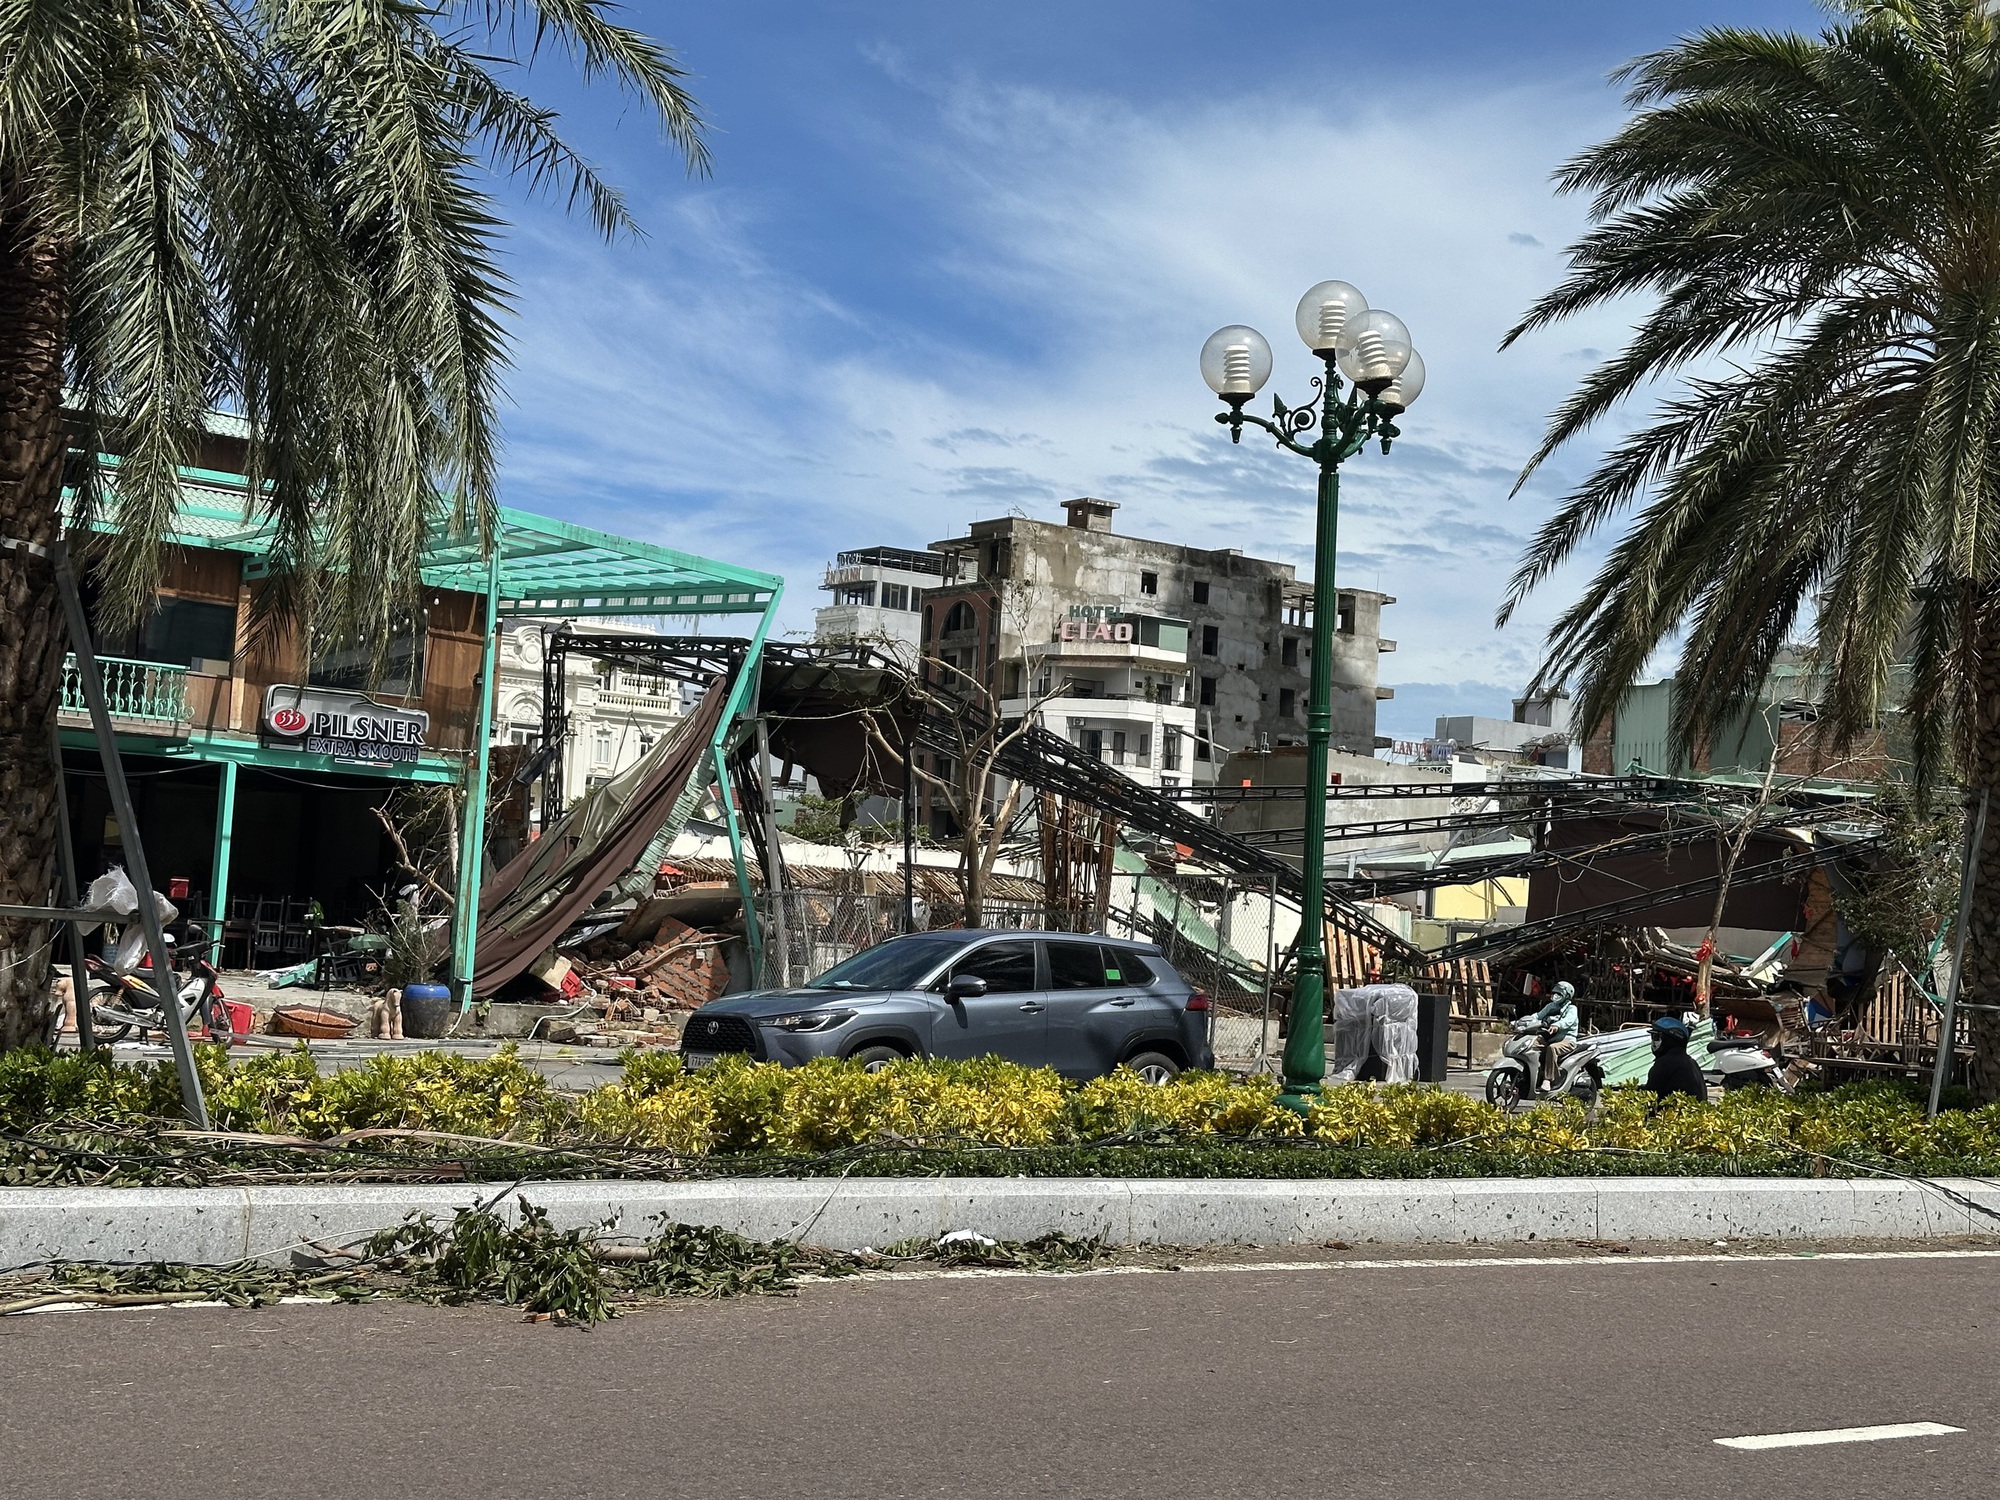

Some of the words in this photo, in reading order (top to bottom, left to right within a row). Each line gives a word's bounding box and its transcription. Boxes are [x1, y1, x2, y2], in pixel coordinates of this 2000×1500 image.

[1069, 605, 1123, 618] HOTEL
[1061, 622, 1133, 641] CIAO
[279, 708, 301, 727] 333
[313, 712, 425, 745] PILSNER
[308, 737, 355, 757] EXTRA
[359, 742, 420, 763] SMOOTH
[1392, 740, 1413, 755] LAN
